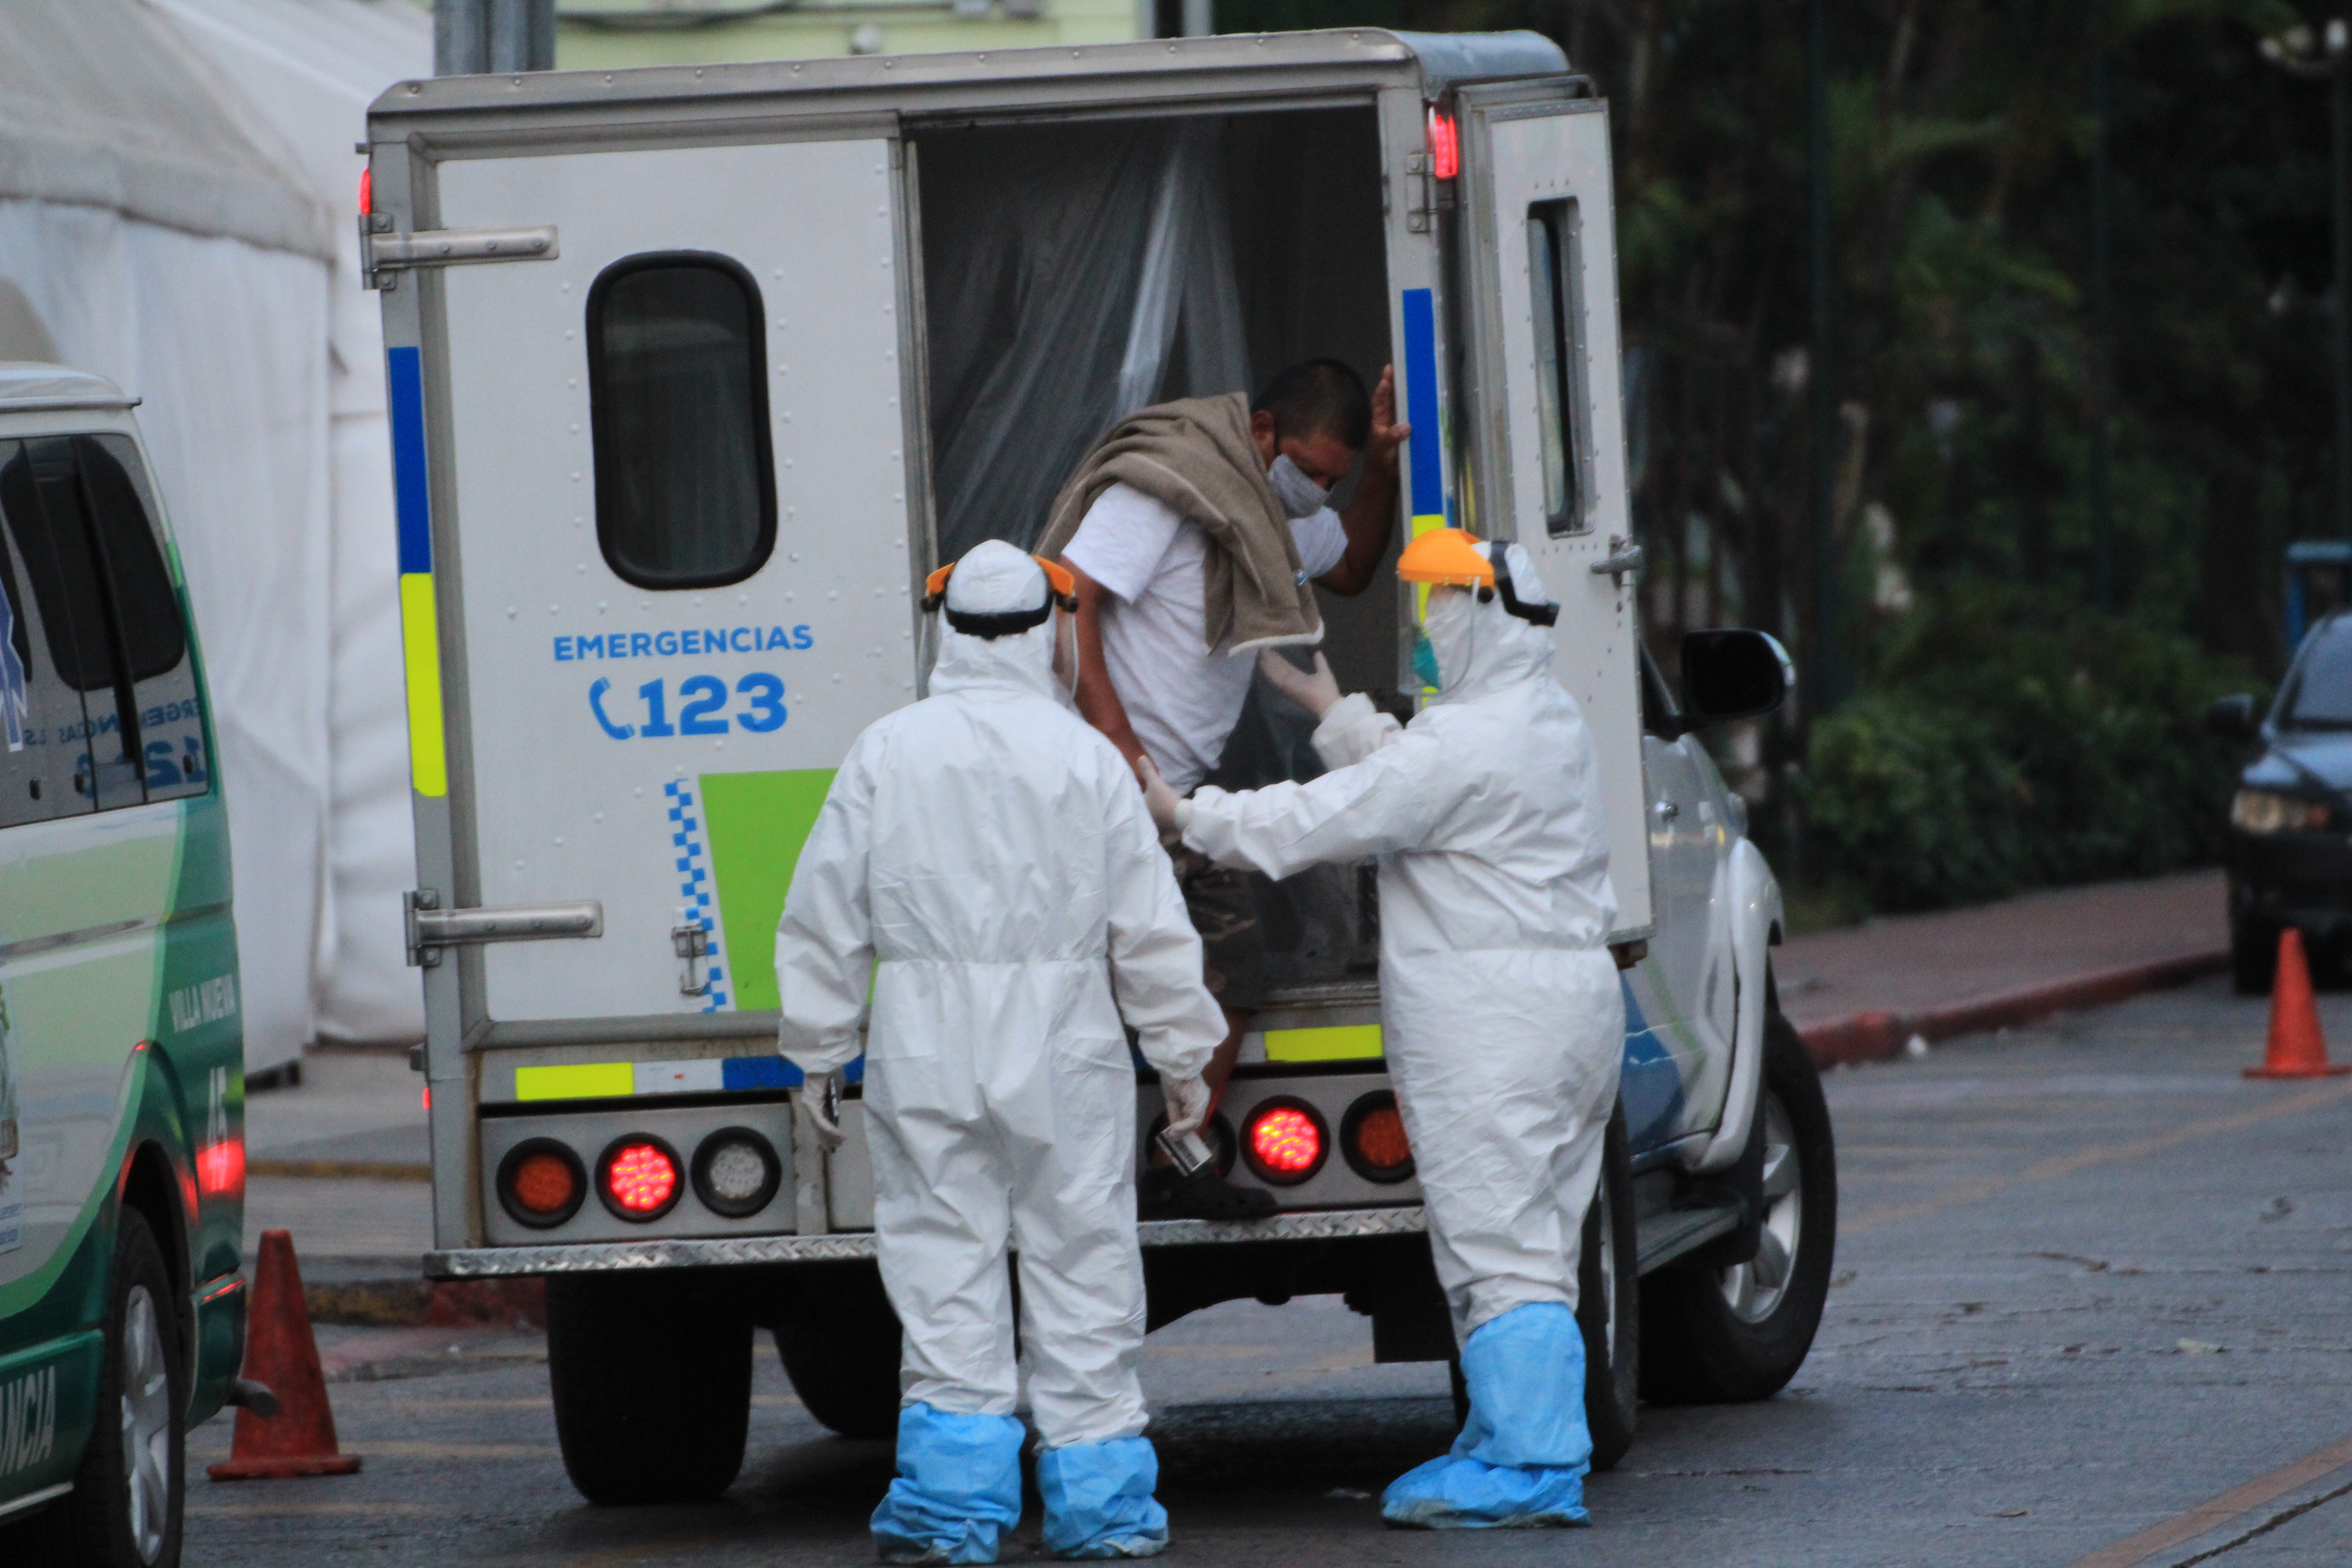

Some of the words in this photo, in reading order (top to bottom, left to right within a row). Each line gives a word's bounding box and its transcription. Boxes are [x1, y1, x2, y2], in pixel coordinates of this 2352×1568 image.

[553, 624, 813, 661] EMERGENCIAS
[639, 671, 788, 738] 123
[0, 1365, 56, 1476] NCIA
